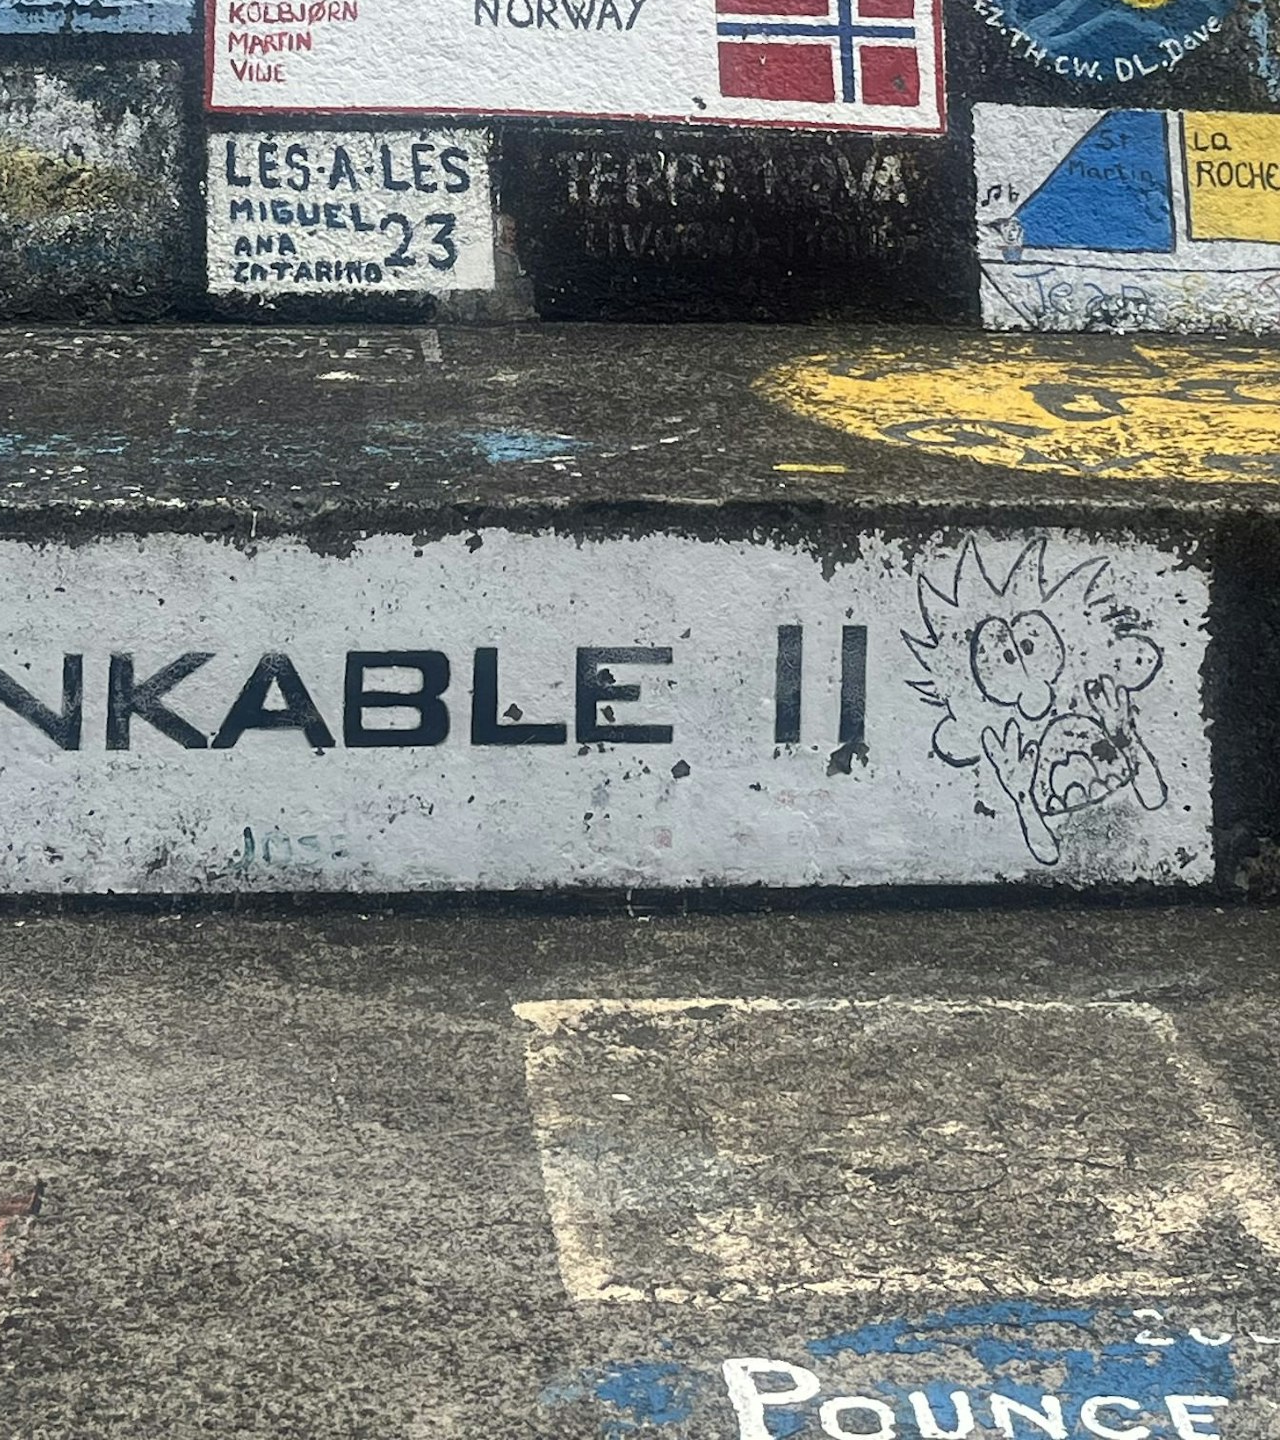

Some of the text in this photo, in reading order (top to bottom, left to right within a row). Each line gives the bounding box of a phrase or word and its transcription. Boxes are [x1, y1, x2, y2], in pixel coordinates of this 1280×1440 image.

[228, 0, 358, 25] KOLBJØRN
[228, 31, 313, 55] MARTIN
[230, 198, 375, 231] MIGUEL
[234, 233, 297, 257] ANA
[379, 212, 459, 271] 23
[720, 1356, 1232, 1440] POUNCE
